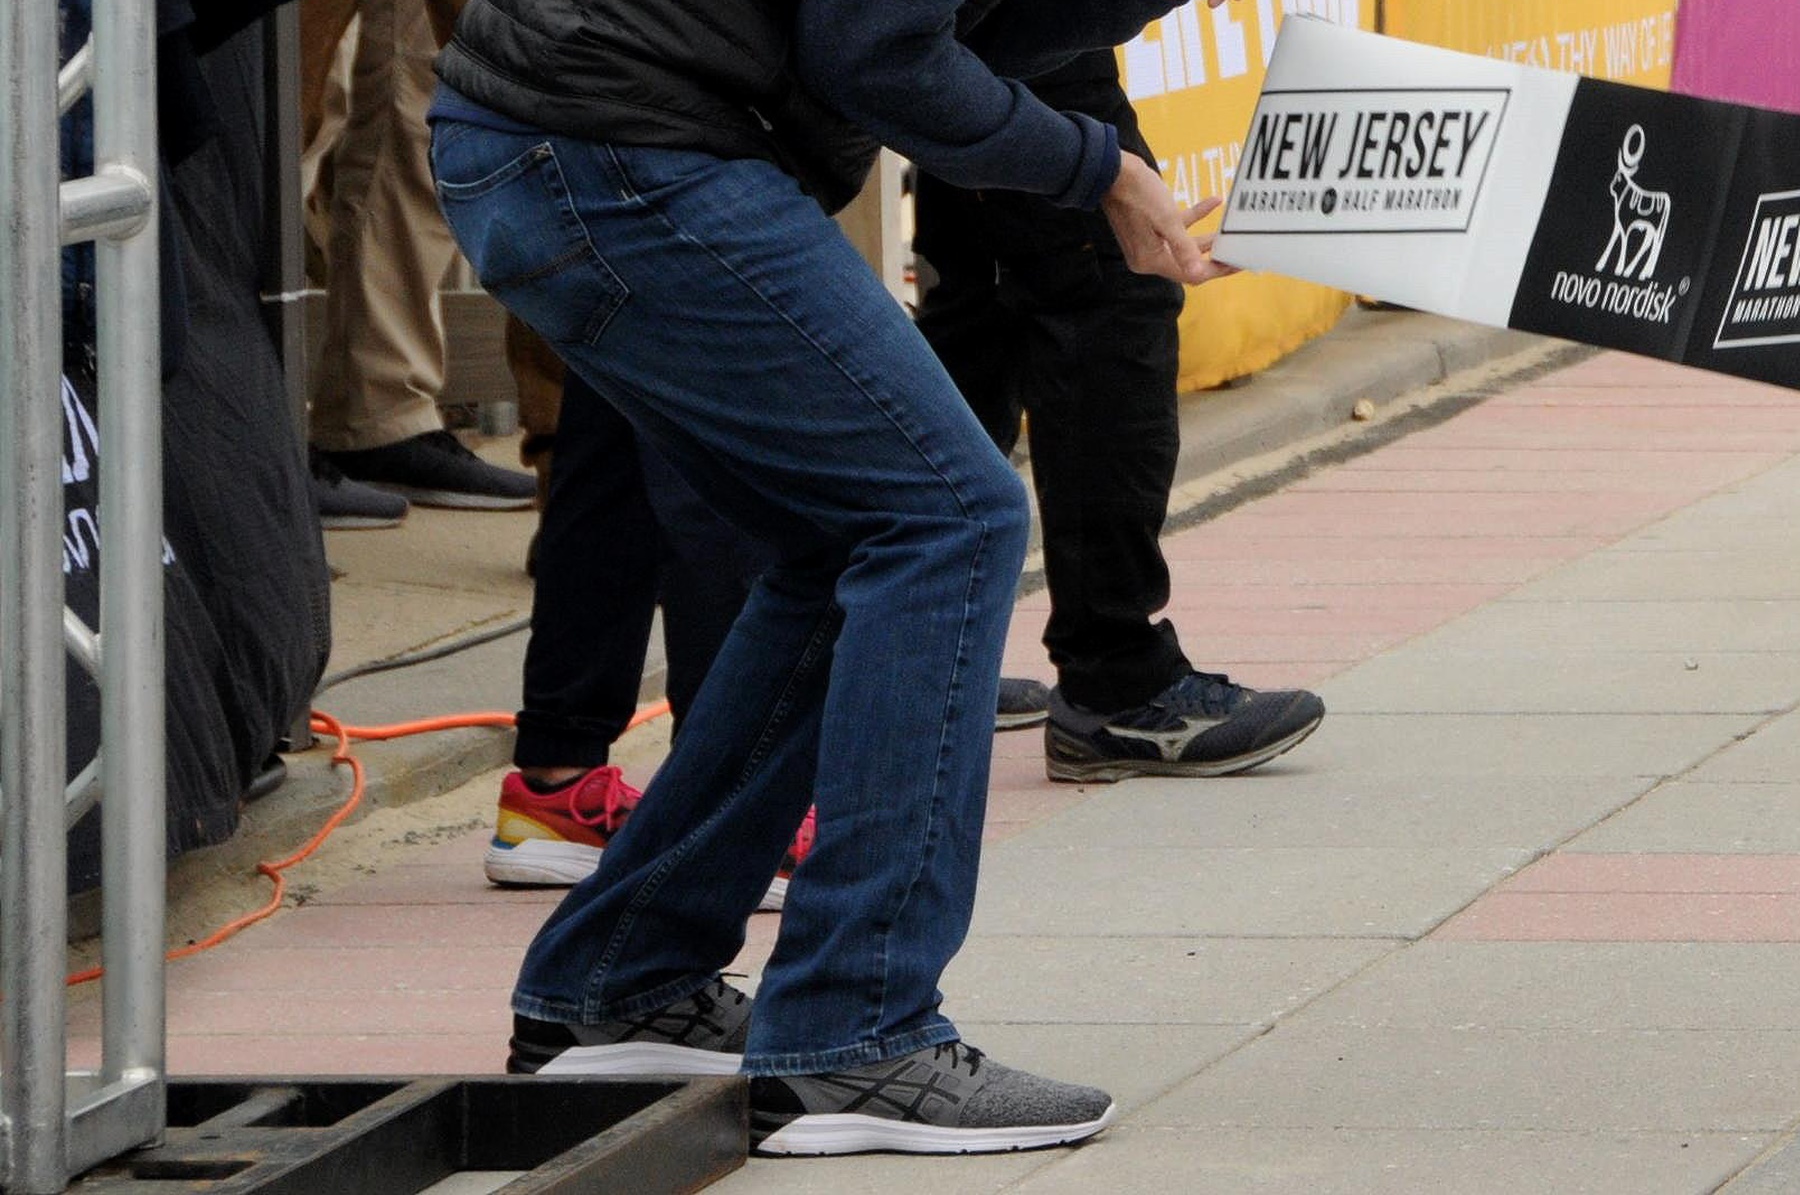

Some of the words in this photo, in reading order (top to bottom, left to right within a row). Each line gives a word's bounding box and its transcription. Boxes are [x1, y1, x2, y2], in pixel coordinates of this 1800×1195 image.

[1603, 21, 1637, 80] WAY
[1246, 111, 1338, 181] NEW
[1337, 110, 1490, 180] JERSEY
[1238, 189, 1317, 213] MARATHON
[1341, 189, 1381, 213] HALF
[1382, 188, 1462, 212] MARATHON
[1551, 270, 1601, 308] novo
[1600, 280, 1677, 325] nordisk
